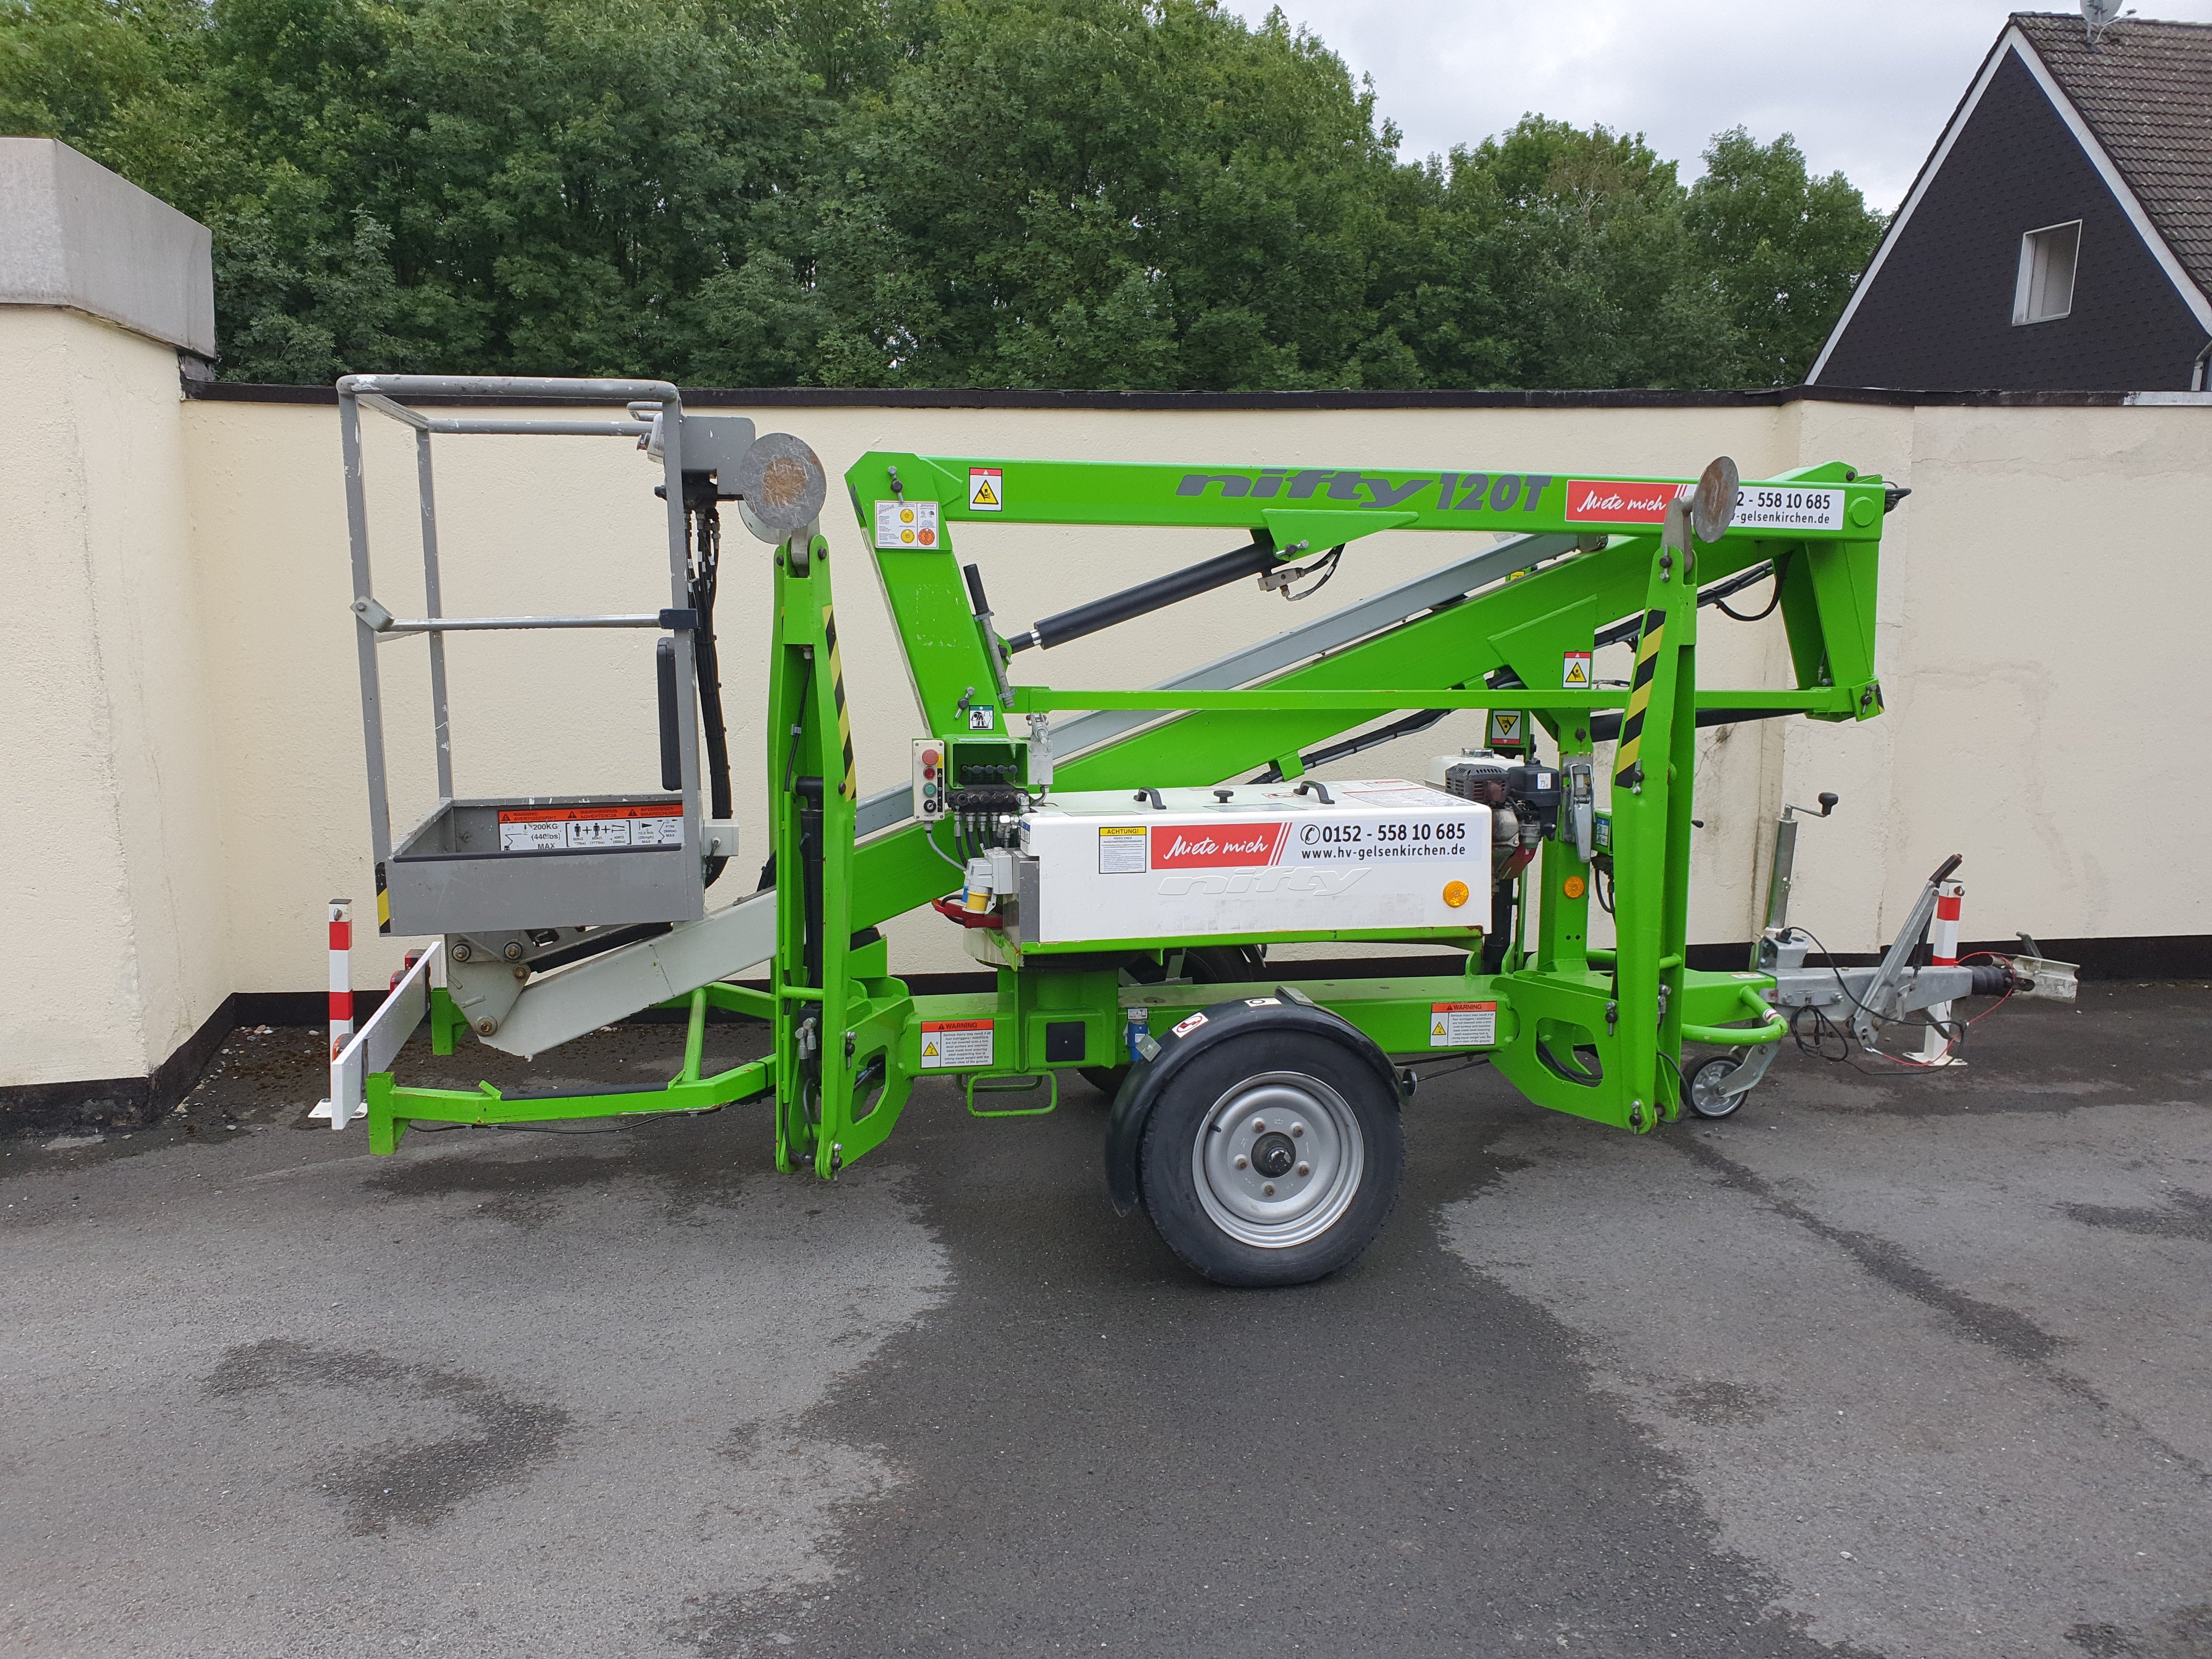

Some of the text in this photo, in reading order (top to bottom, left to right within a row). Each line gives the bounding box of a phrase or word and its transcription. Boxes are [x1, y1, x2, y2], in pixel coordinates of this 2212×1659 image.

[1175, 469, 1552, 511] nifty 120T
[1757, 491, 1782, 507] 558
[1786, 492, 1802, 509] 10
[1806, 494, 1831, 510] 685
[1576, 490, 1667, 513] Miete mich
[531, 833, 561, 842] (440lbs)
[1322, 826, 1361, 843] 0152
[1377, 824, 1407, 842] 558
[1412, 823, 1431, 840] 10
[1436, 823, 1465, 840] 685
[1163, 834, 1220, 860] Miete
[1222, 835, 1269, 855] mich
[1301, 843, 1465, 861] www.hv-gelsenkirchen.de
[1158, 866, 1372, 896] nifty
